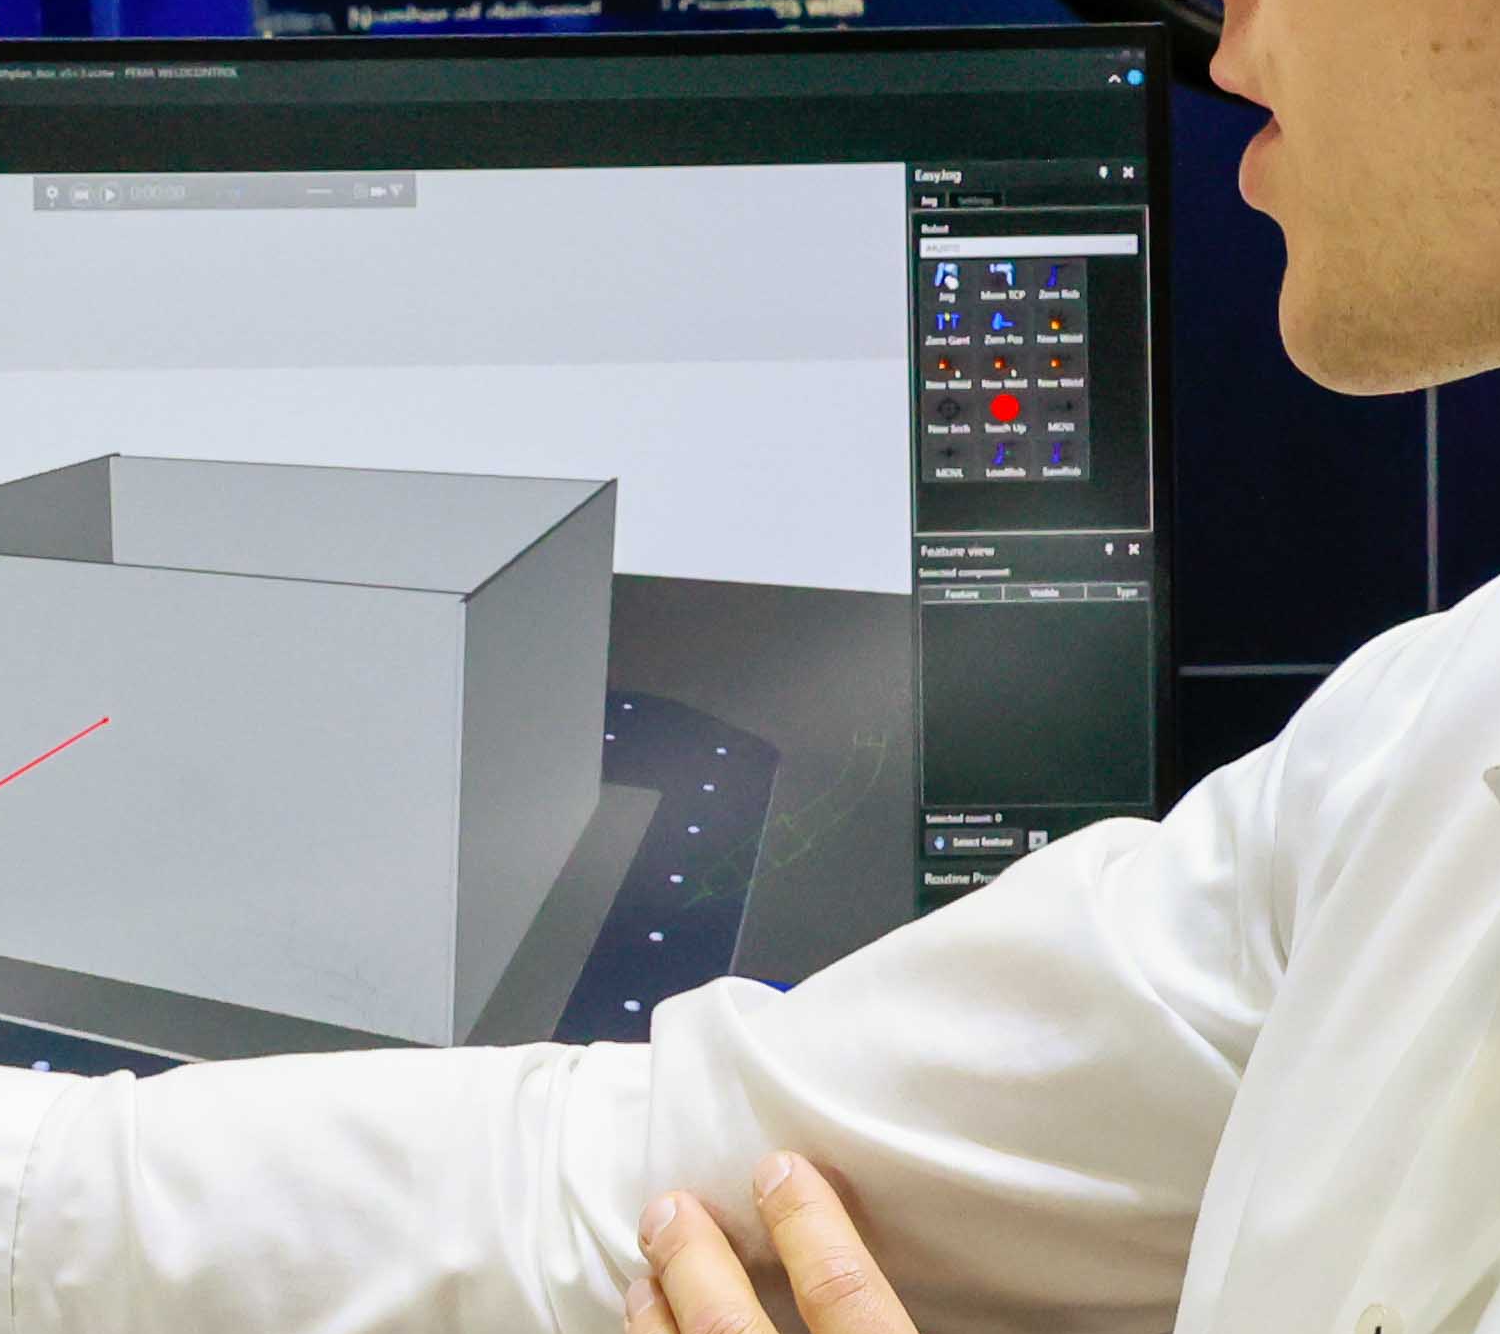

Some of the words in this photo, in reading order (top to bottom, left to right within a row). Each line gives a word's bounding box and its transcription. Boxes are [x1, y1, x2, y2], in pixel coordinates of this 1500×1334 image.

[921, 545, 966, 558] Feature
[968, 546, 995, 556] view
[924, 872, 970, 885] Routine
[972, 871, 1000, 884] Pro
